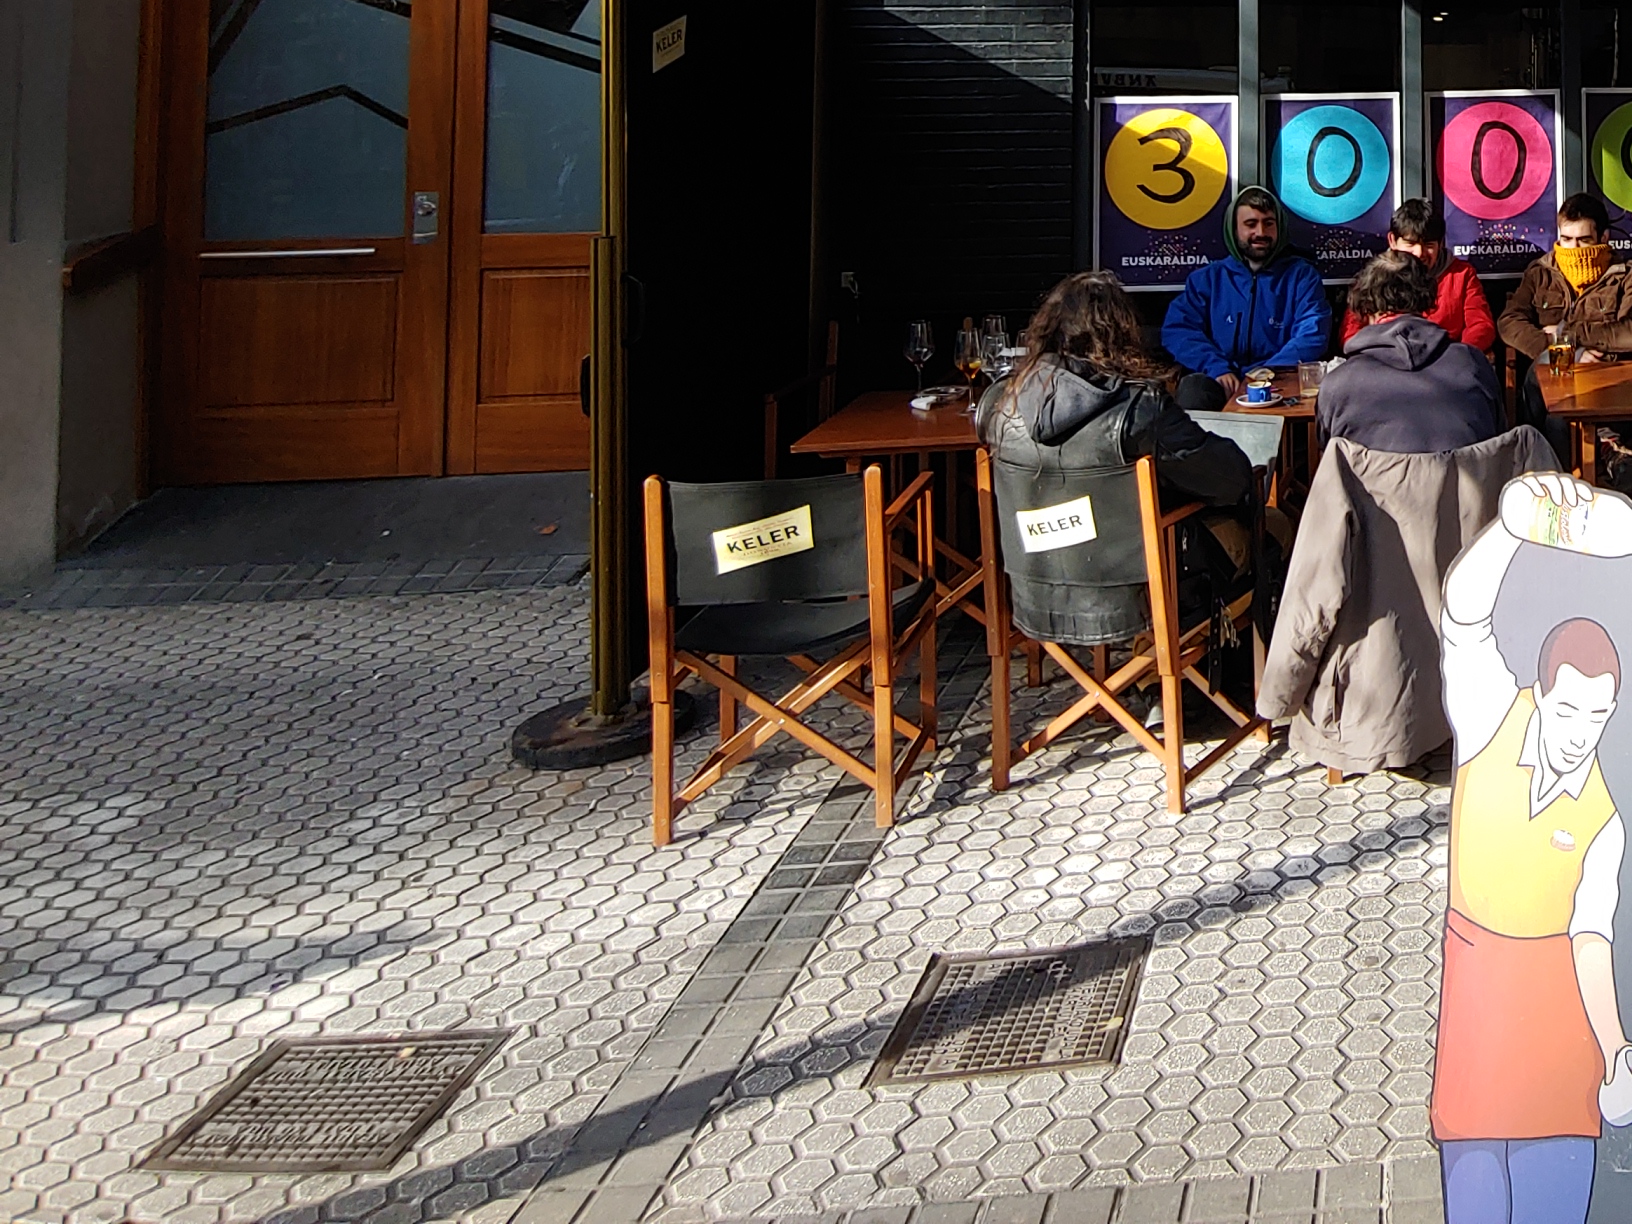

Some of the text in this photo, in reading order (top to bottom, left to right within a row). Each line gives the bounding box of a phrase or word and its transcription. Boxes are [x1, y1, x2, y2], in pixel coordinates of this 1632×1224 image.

[656, 29, 683, 55] KELER
[1136, 127, 1197, 204] 3
[1121, 255, 1210, 266] EUSKARALDIA
[1454, 244, 1537, 256] EUSKARALDIA
[1026, 513, 1083, 538] KELER
[726, 525, 800, 553] KELER
